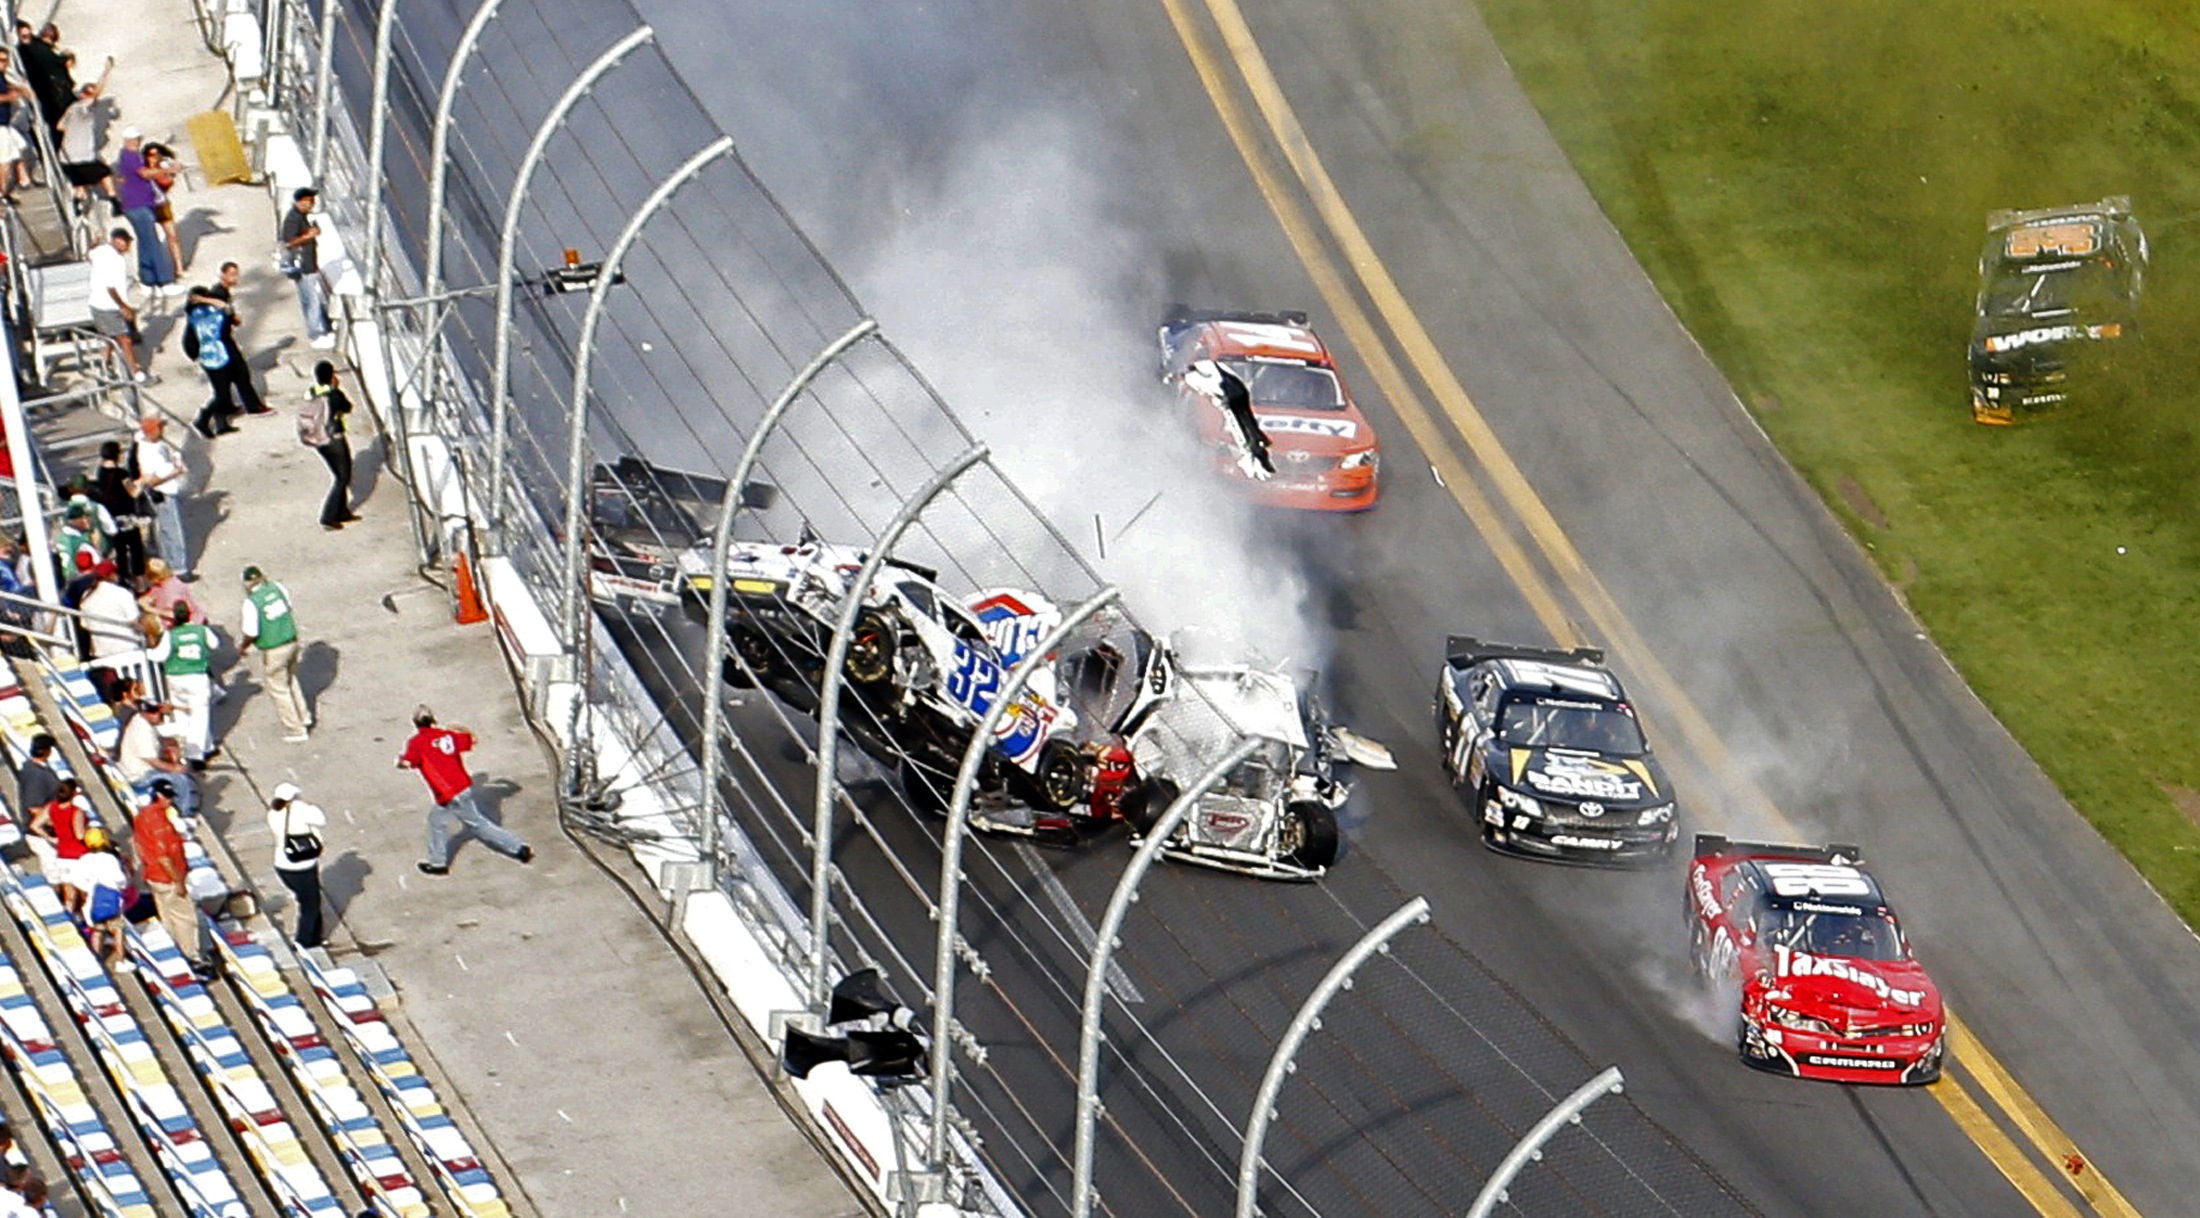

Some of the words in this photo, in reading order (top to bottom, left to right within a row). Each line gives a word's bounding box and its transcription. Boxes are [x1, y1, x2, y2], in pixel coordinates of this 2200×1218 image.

[948, 641, 999, 718] 32
[1551, 834, 1624, 849] CAMRY
[1774, 943, 1926, 1007] TaxSlayer
[1809, 1056, 1896, 1069] CAMARO
